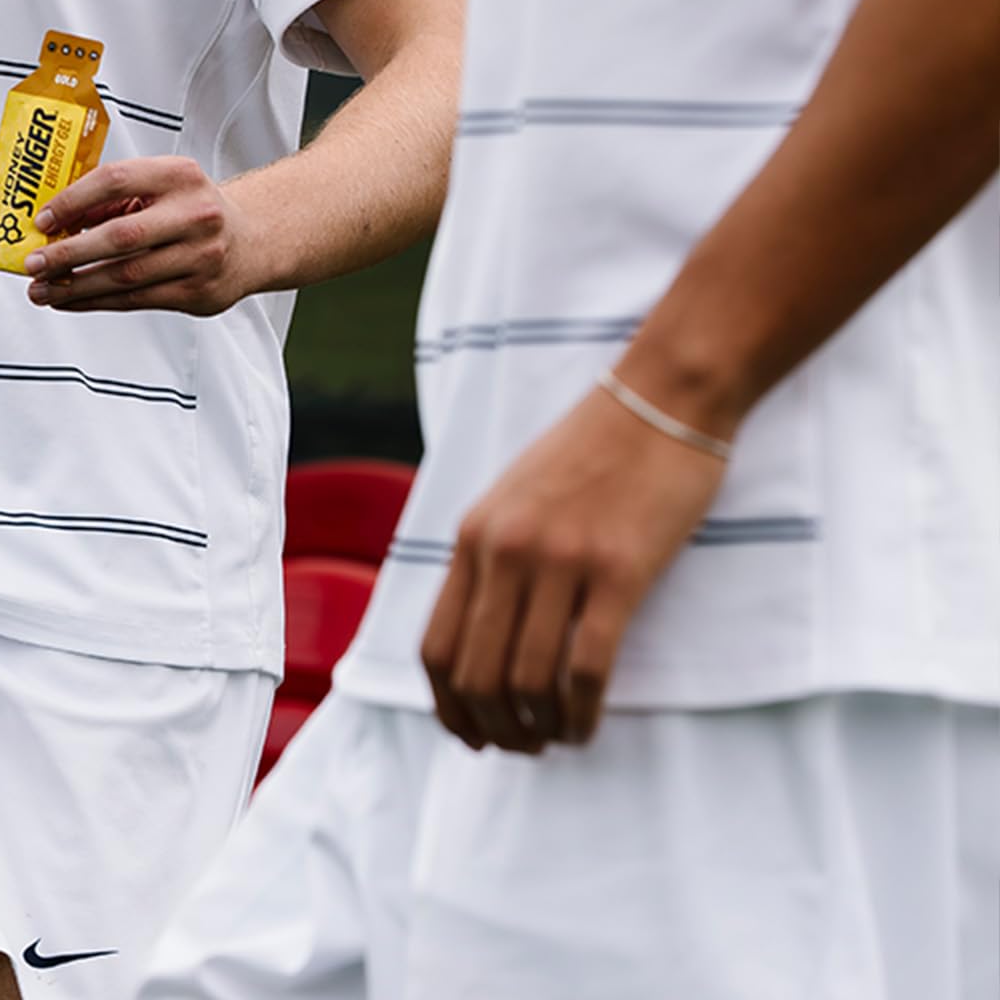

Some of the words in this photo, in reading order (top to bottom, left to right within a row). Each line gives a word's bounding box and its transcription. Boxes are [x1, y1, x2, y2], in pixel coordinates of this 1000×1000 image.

[2, 131, 24, 206] HONEY
[11, 107, 57, 218] STINGER
[45, 138, 66, 189] ENERGY
[56, 117, 73, 140] GEL
